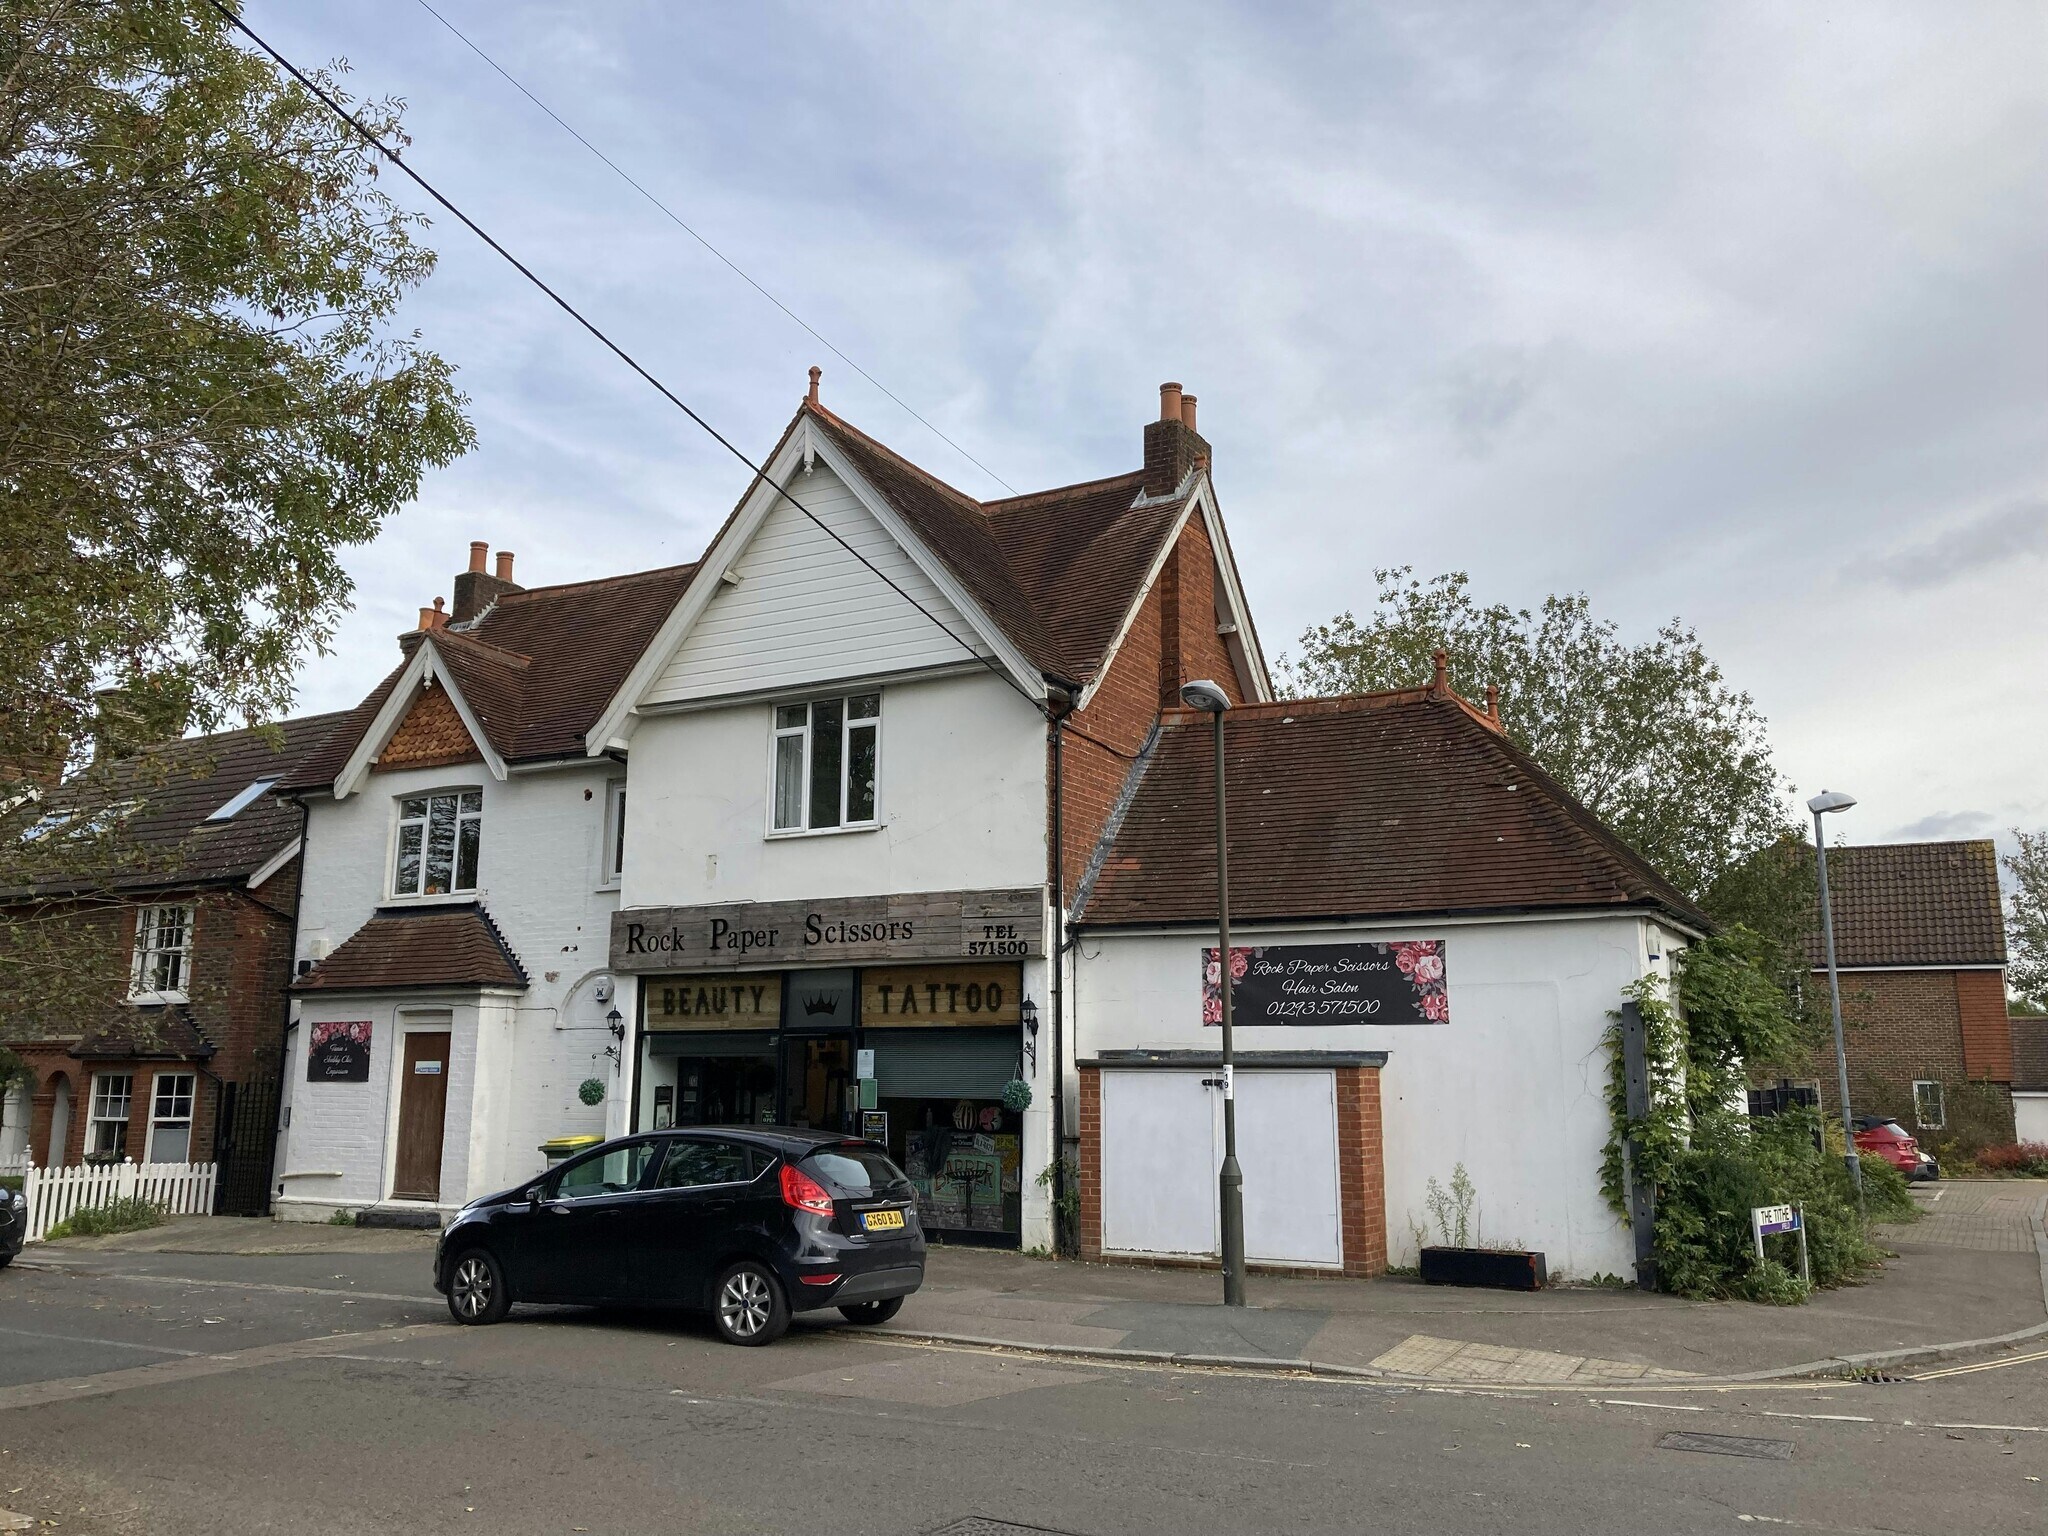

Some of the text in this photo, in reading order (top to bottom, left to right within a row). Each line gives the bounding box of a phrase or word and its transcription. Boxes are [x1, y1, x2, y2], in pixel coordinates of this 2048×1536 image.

[626, 913, 913, 954] Rock Paper Scissors
[982, 925, 1018, 939] TEL
[968, 941, 1029, 955] 571500
[1252, 958, 1391, 976] Rock Paper Scissors
[1281, 978, 1360, 995] Hair Salon
[663, 985, 766, 1016] BEAUTY
[878, 982, 1002, 1014] TATTOO
[1266, 999, 1381, 1018] 01293 571500
[866, 1211, 902, 1227] GX60 BJU
[1761, 1208, 1790, 1225] THE TITHE
